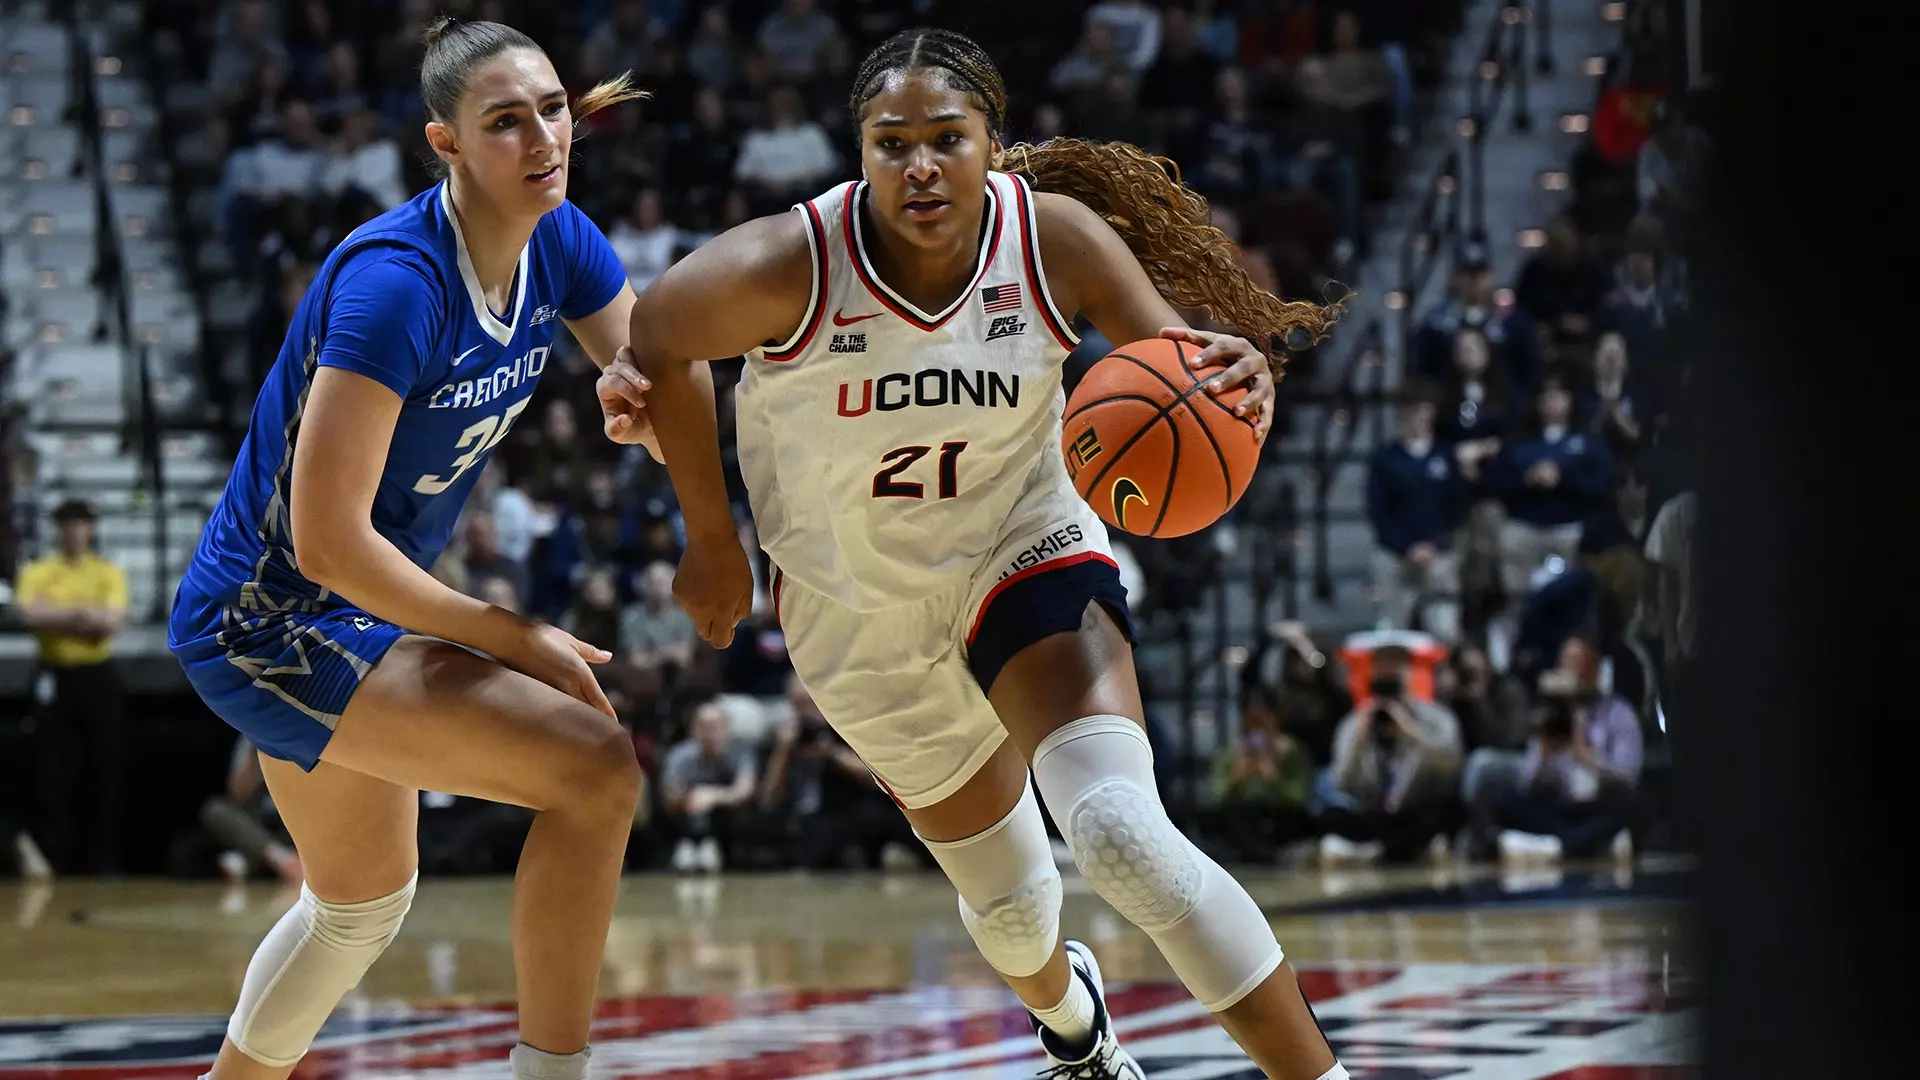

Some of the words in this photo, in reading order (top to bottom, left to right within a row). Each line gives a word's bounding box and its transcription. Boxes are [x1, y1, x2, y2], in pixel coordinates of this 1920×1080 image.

[987, 322, 1027, 336] EAST
[991, 315, 1018, 328] BIG
[828, 343, 868, 353] CHANGE
[832, 334, 846, 344] BE
[848, 334, 866, 344] THE
[428, 342, 553, 409] CREIGHTO
[837, 368, 1019, 418] UCONN
[871, 441, 969, 499] 21
[998, 524, 1084, 581] SKIES
